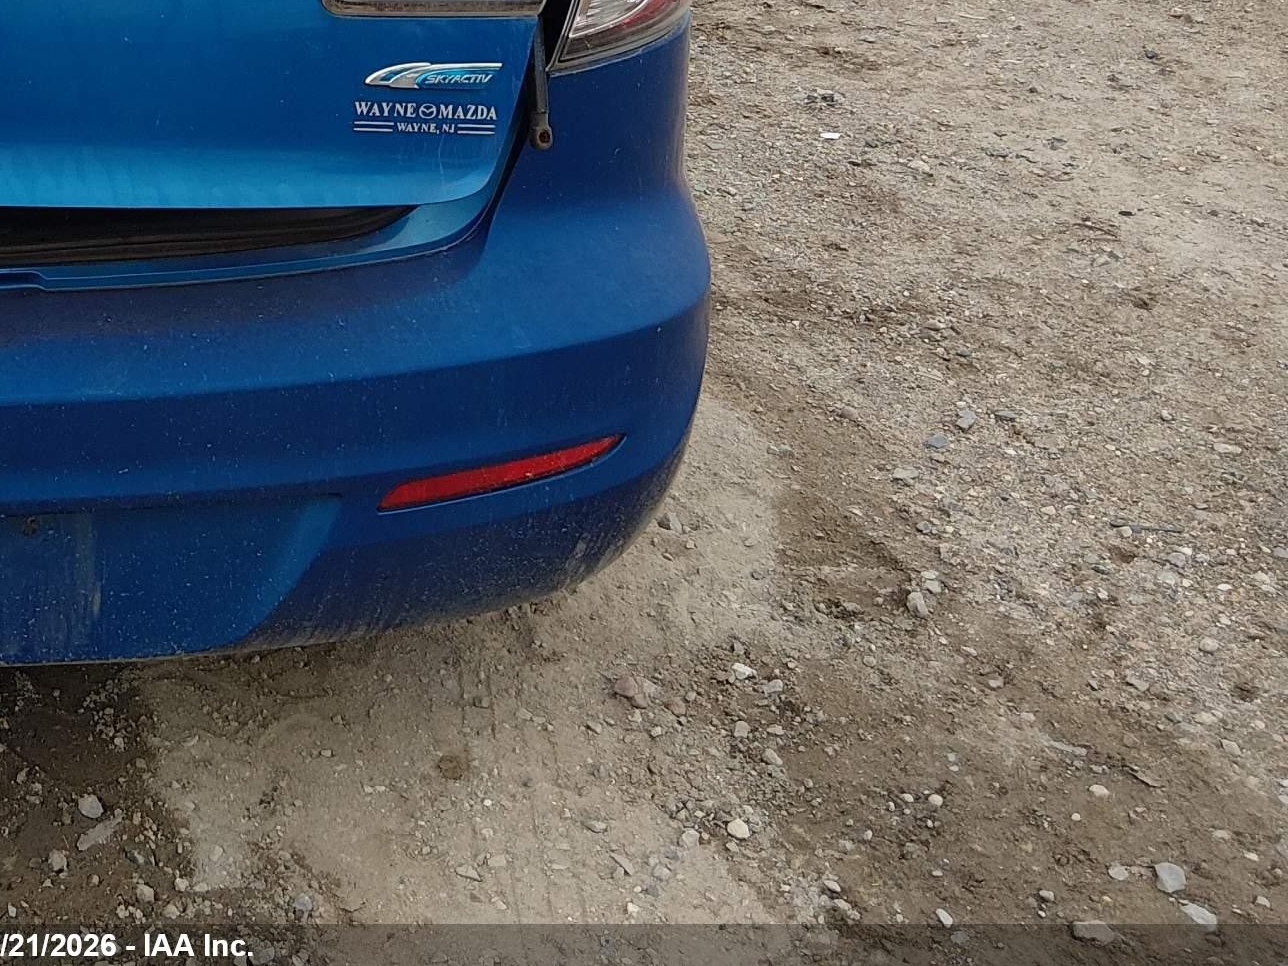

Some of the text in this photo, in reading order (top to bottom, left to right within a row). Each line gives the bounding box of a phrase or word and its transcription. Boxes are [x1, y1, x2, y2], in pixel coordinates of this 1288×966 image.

[424, 73, 493, 84] SKYACTIV
[354, 101, 497, 120] WAYNE MAZDA
[397, 122, 455, 135] WAYNE, NJ
